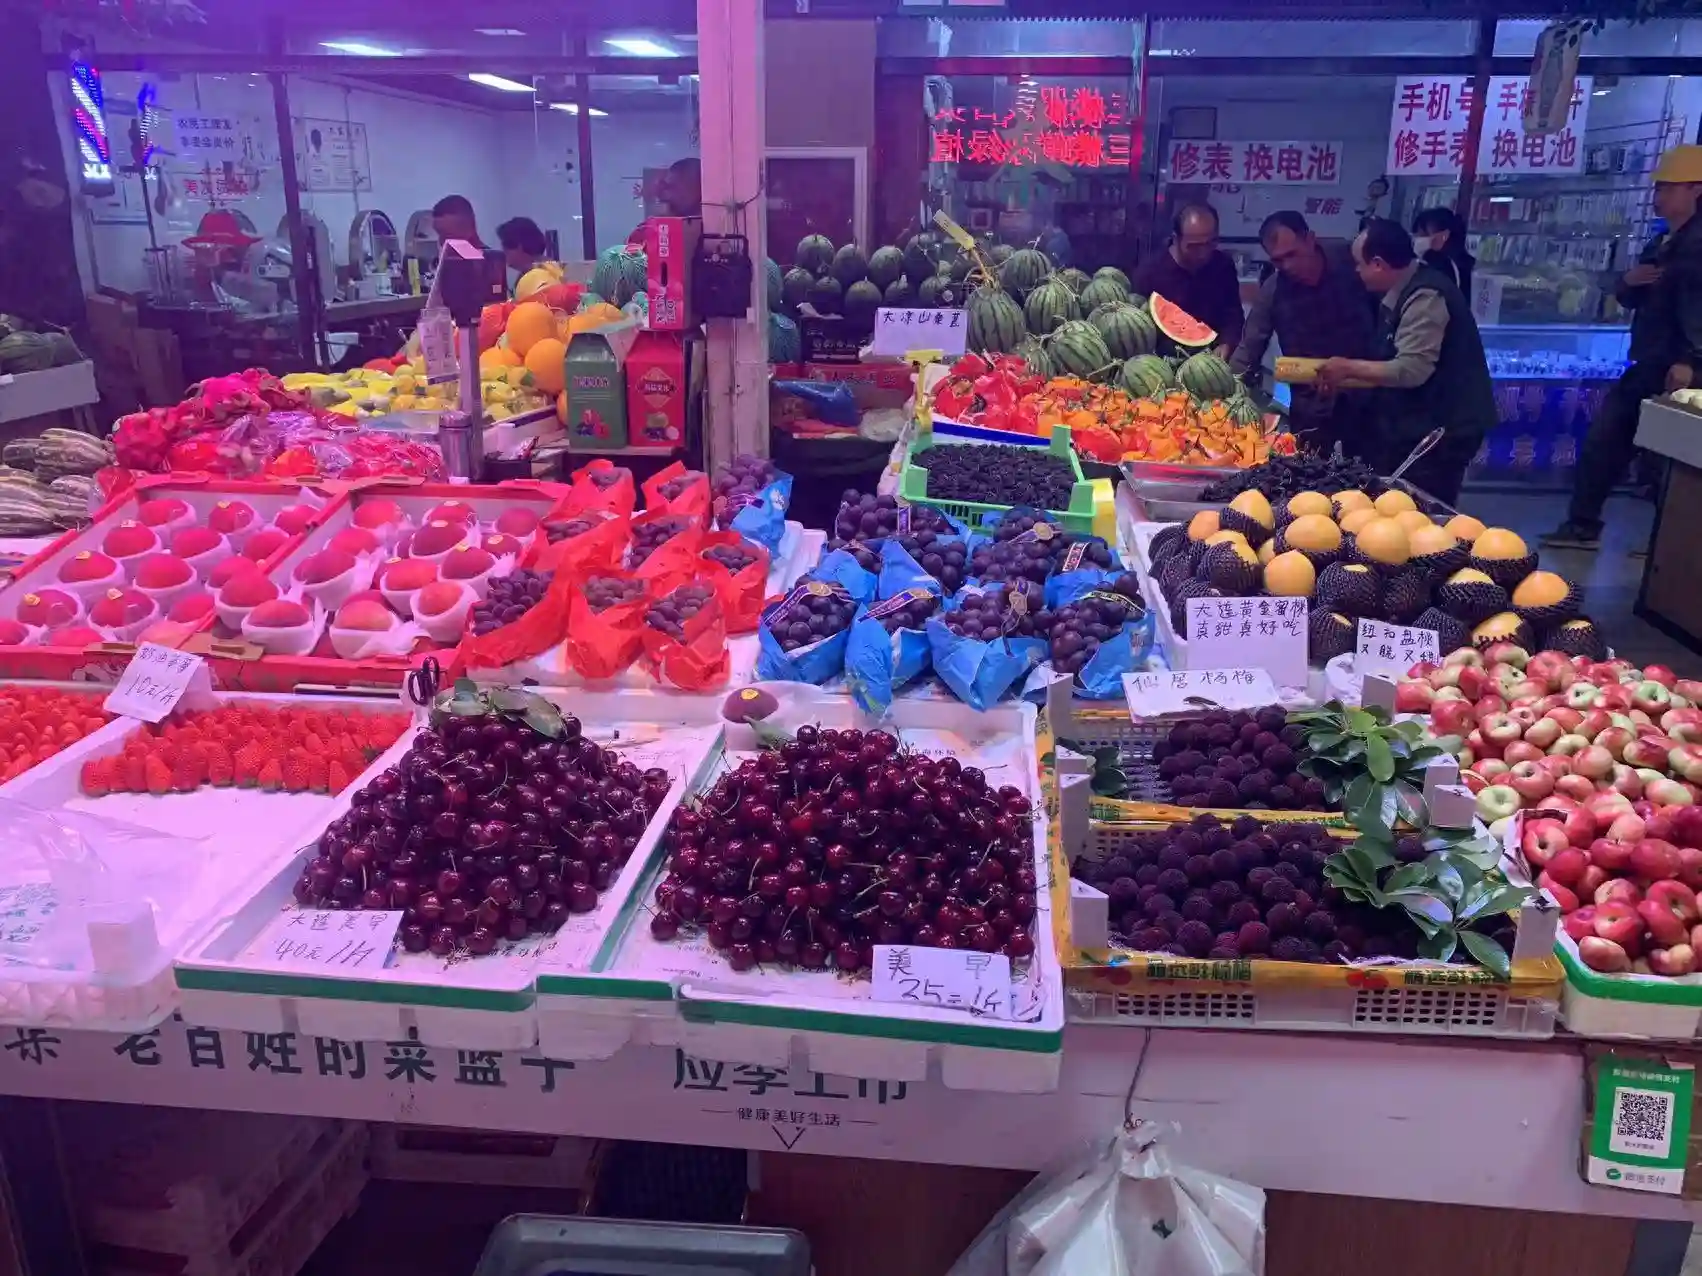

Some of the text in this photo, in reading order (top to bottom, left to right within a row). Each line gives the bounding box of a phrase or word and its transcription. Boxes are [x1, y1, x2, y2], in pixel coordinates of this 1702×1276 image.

[1171, 143, 1336, 181] 修表 换电池
[1492, 127, 1577, 169] 换电池
[736, 1106, 841, 1127] 健康美好生活
